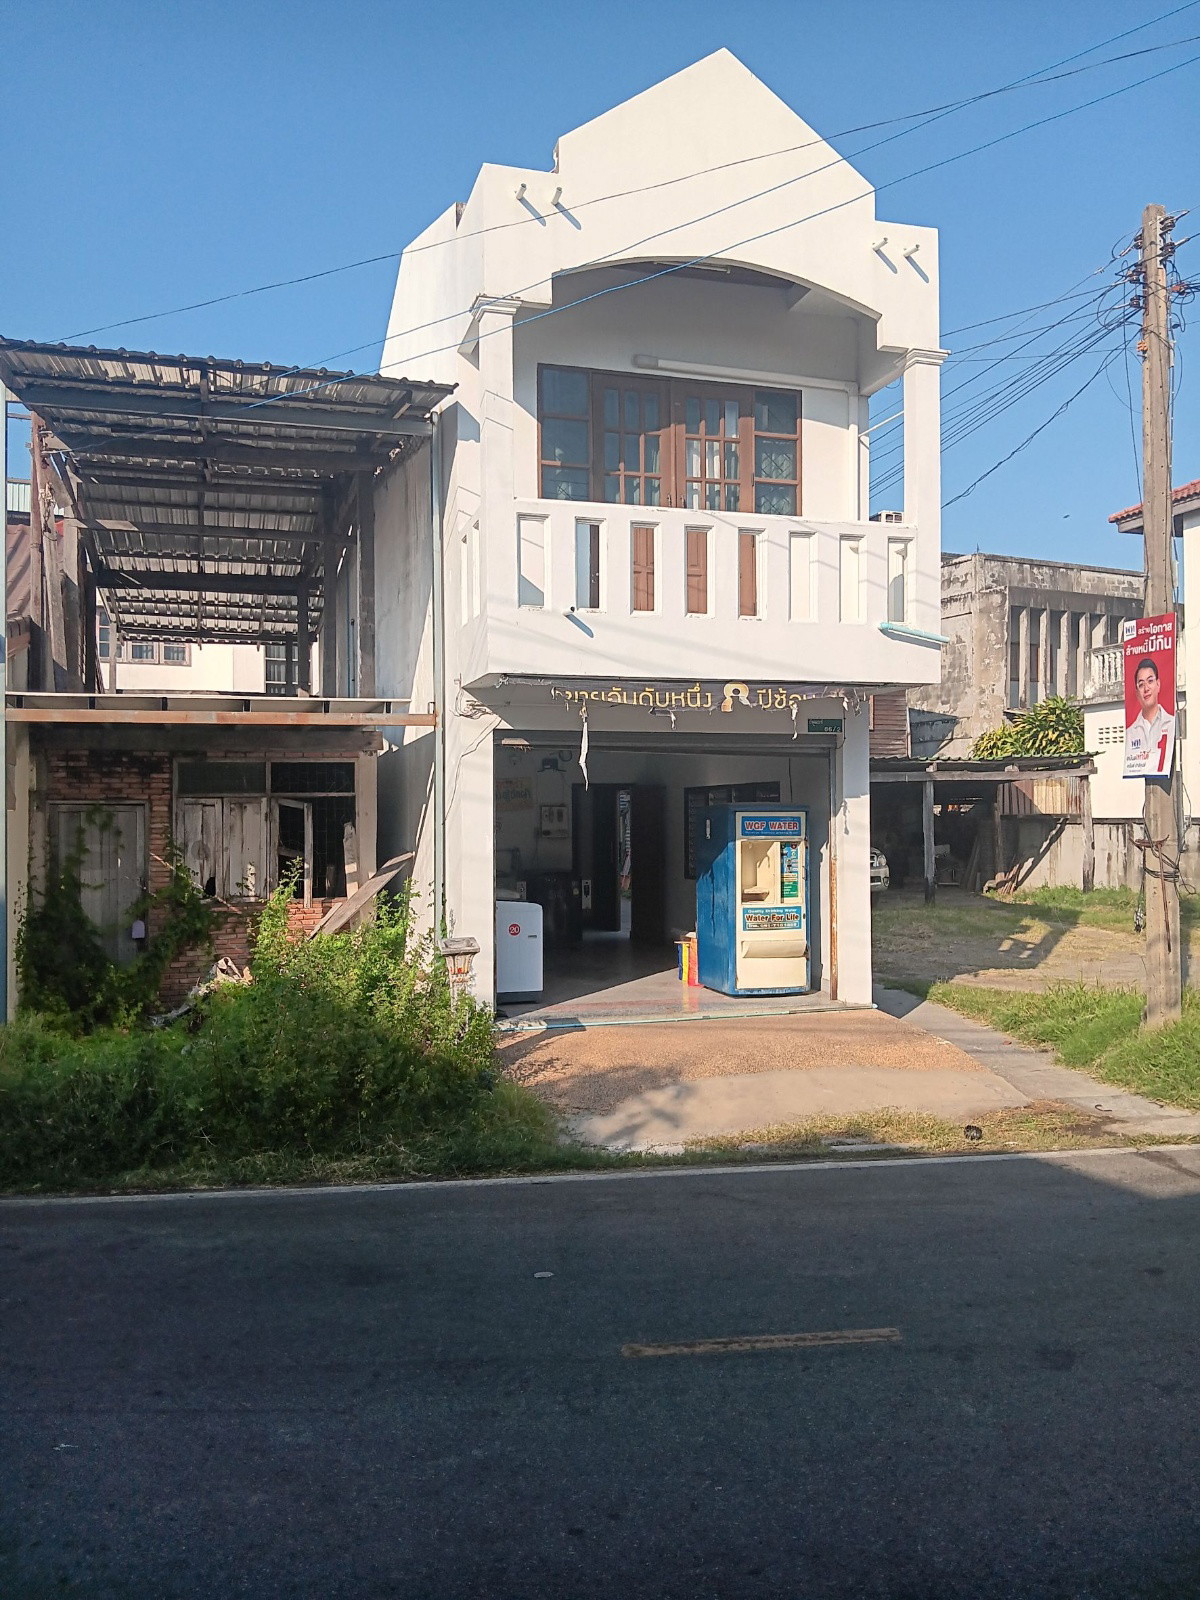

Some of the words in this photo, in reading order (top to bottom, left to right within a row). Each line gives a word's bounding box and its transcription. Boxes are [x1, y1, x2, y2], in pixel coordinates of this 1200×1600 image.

[1157, 734, 1168, 772] 1
[769, 821, 799, 830] WATER
[745, 914, 768, 922] Water
[771, 913, 784, 921] For
[786, 913, 799, 921] Life
